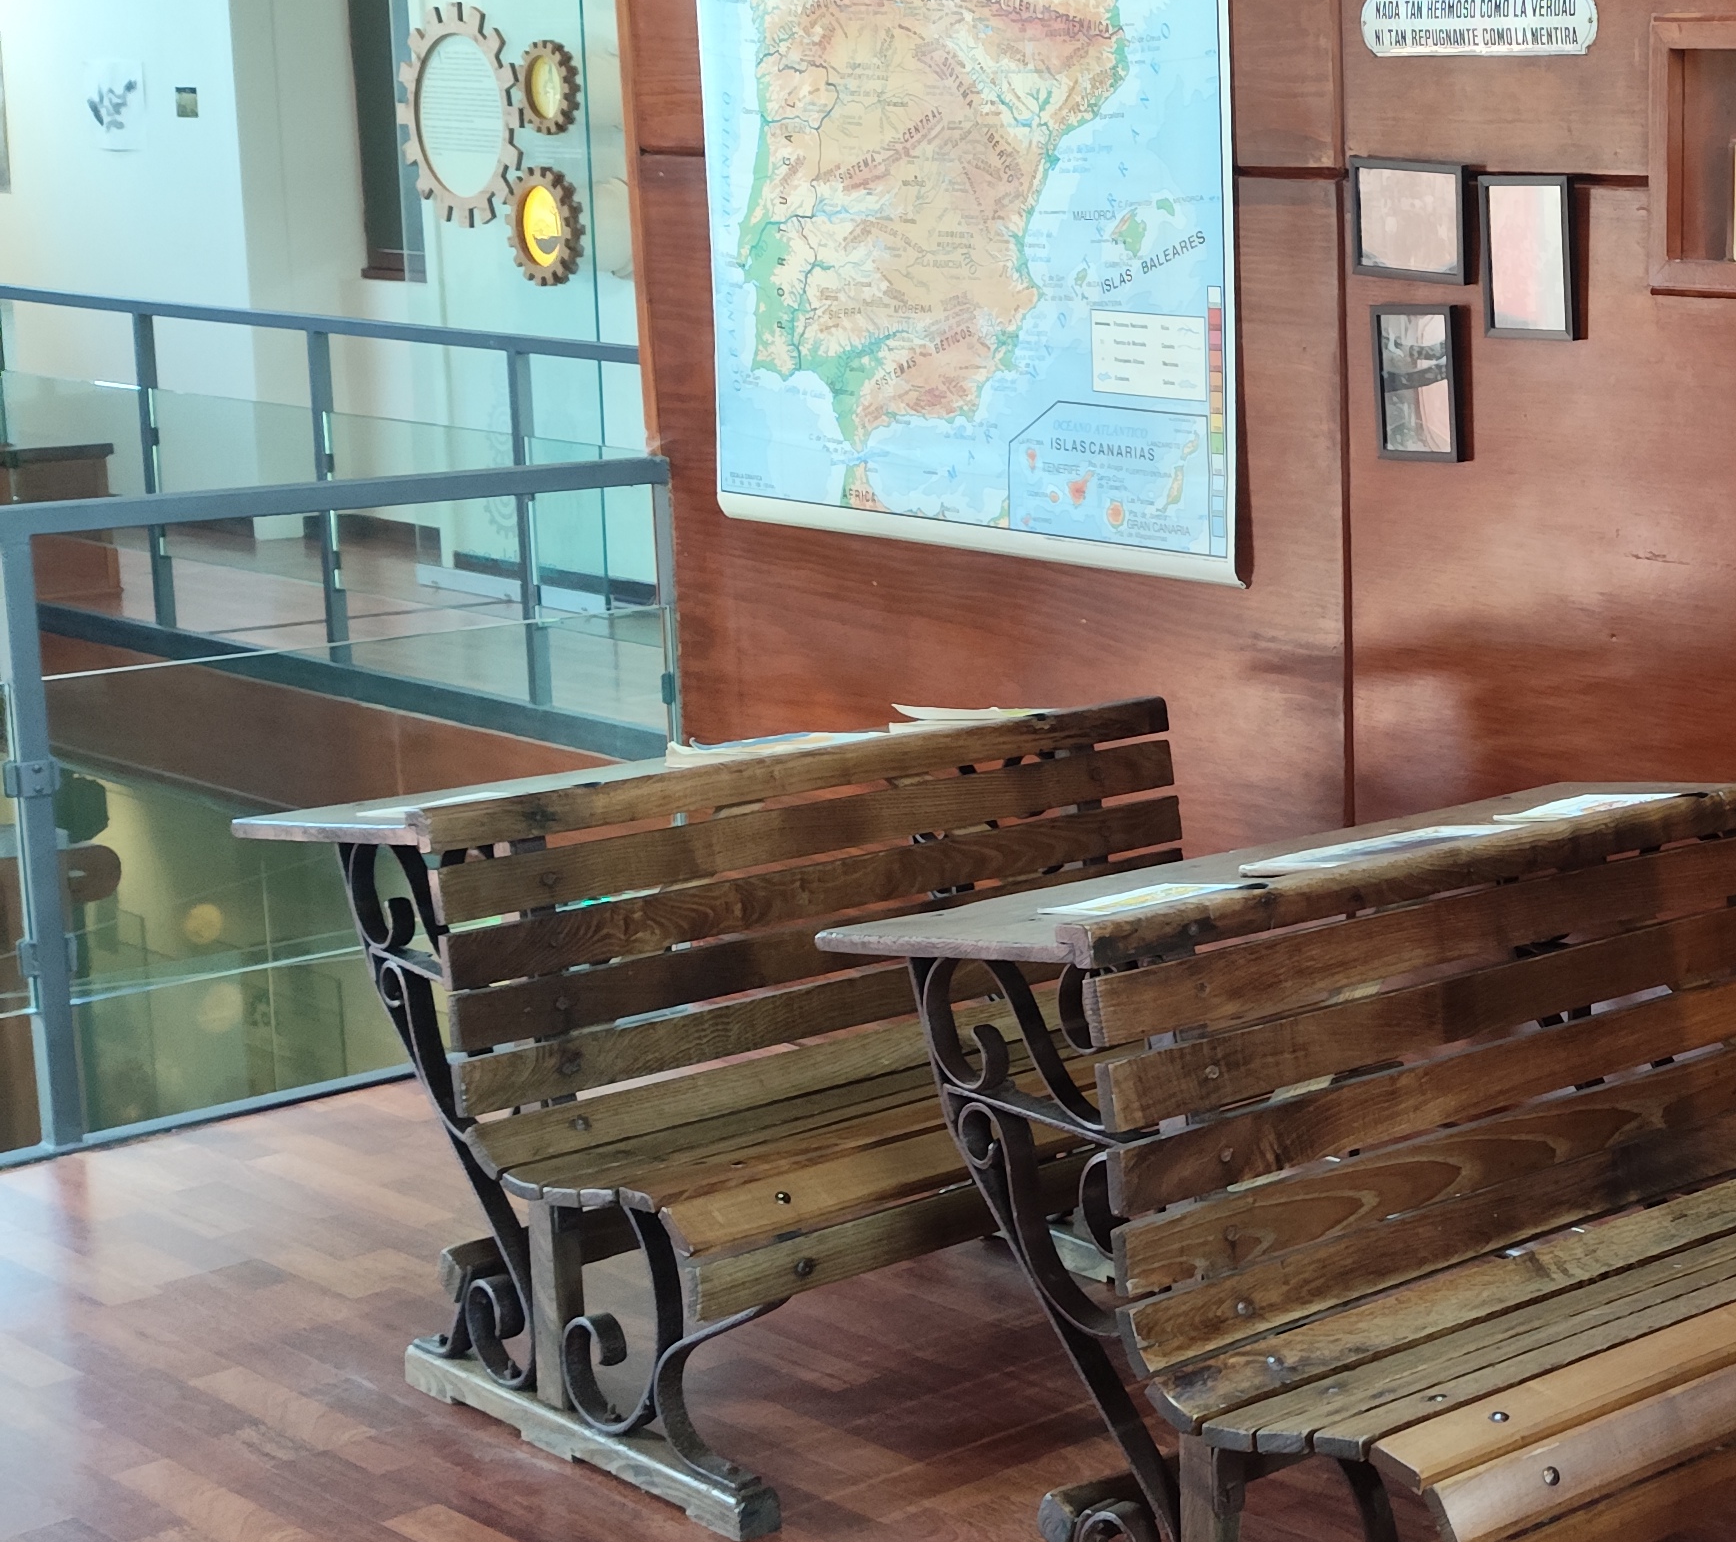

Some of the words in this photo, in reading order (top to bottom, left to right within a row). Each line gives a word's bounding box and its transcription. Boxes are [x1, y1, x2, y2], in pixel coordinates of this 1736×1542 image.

[1376, 0, 1400, 20] NADA
[1405, 0, 1423, 19] TAN
[1427, 0, 1476, 19] HERMOSO
[1374, 29, 1385, 47] NI
[1387, 29, 1407, 46] TAN
[1411, 27, 1479, 46] REPUGNANTE
[1483, 28, 1513, 46] COMO
[1515, 28, 1529, 45] LA
[1531, 26, 1579, 45] MENTIRA
[942, 56, 975, 110] SISTEMA
[838, 153, 876, 183] SISTEMA
[901, 106, 943, 143] CENTRAL
[1073, 209, 1117, 222] MALLORCA
[1101, 268, 1134, 295] ISLAS
[1141, 230, 1207, 275] BALEARES
[828, 307, 863, 320] SIERRA
[893, 304, 932, 315] MORENA
[875, 356, 917, 391] SISTEMAS
[1050, 437, 1088, 454] ISLAS
[1089, 441, 1156, 462] CANARIAS
[1042, 461, 1081, 476] TENERIFE
[1127, 519, 1150, 533] GRAN
[1152, 521, 1191, 537] CANARIA
